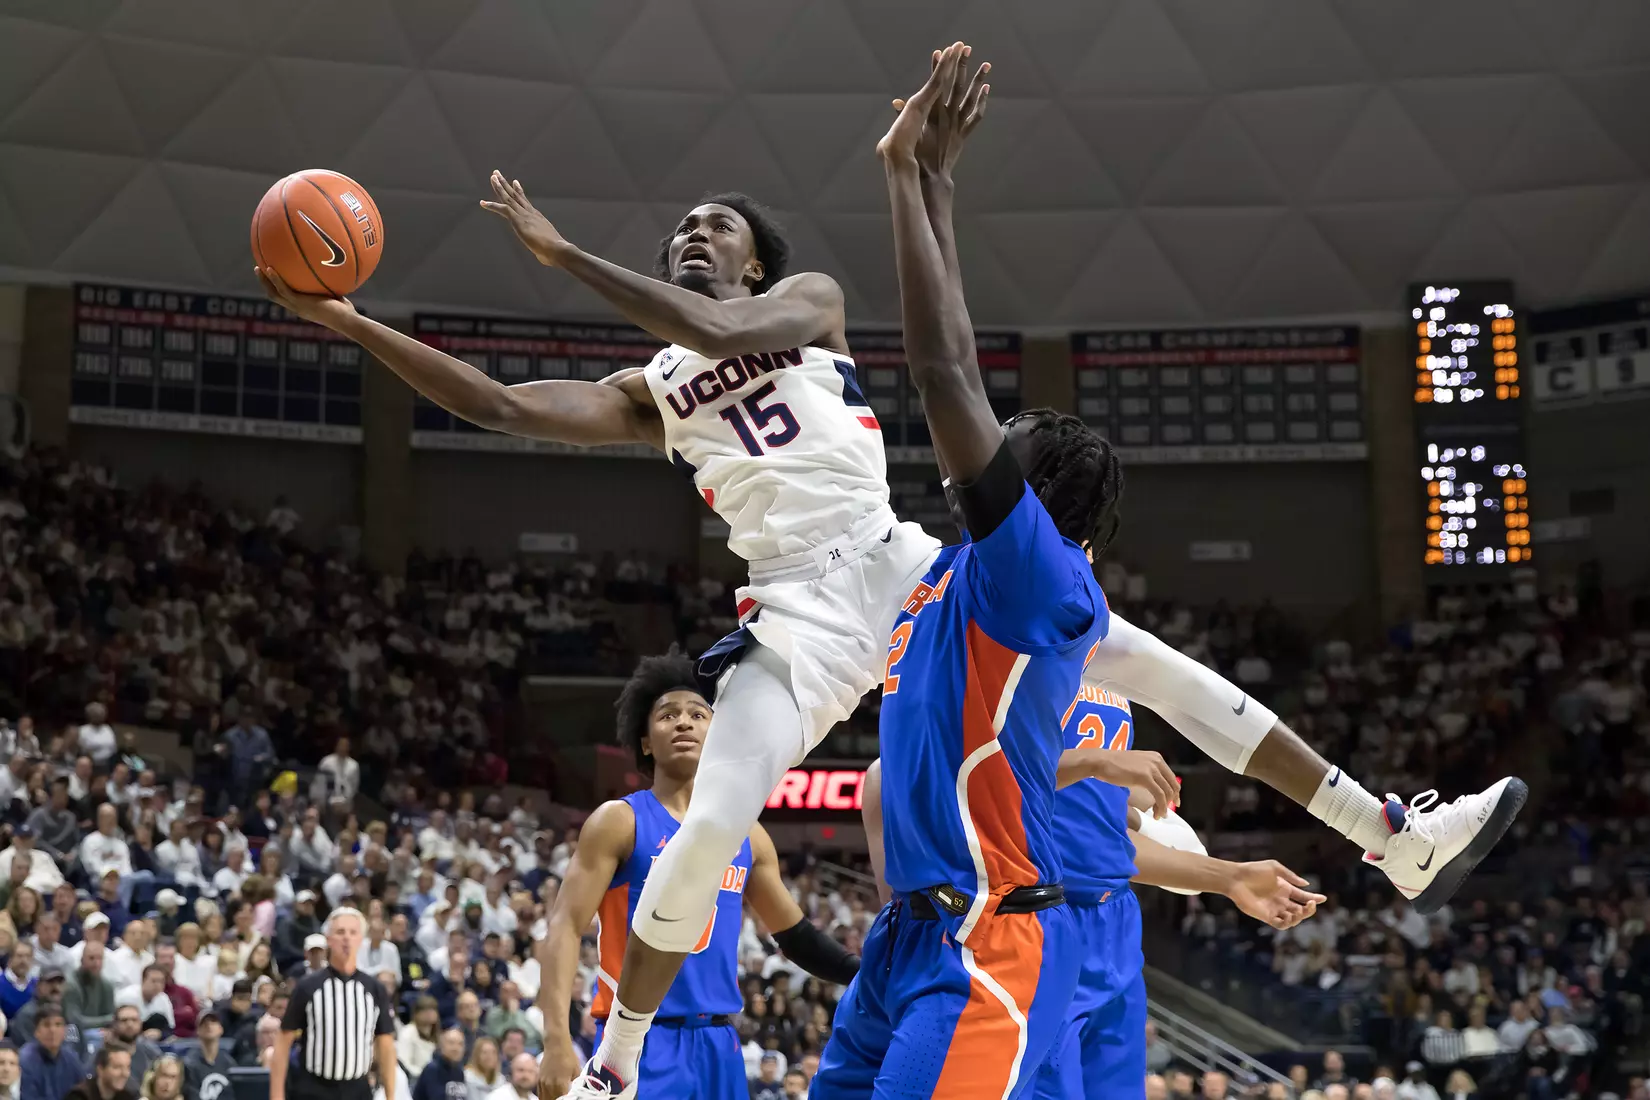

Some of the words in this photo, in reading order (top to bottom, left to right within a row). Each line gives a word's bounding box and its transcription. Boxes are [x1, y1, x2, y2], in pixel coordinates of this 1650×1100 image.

[340, 191, 378, 249] ELITE
[665, 347, 804, 420] UCONN
[717, 379, 802, 457] 15
